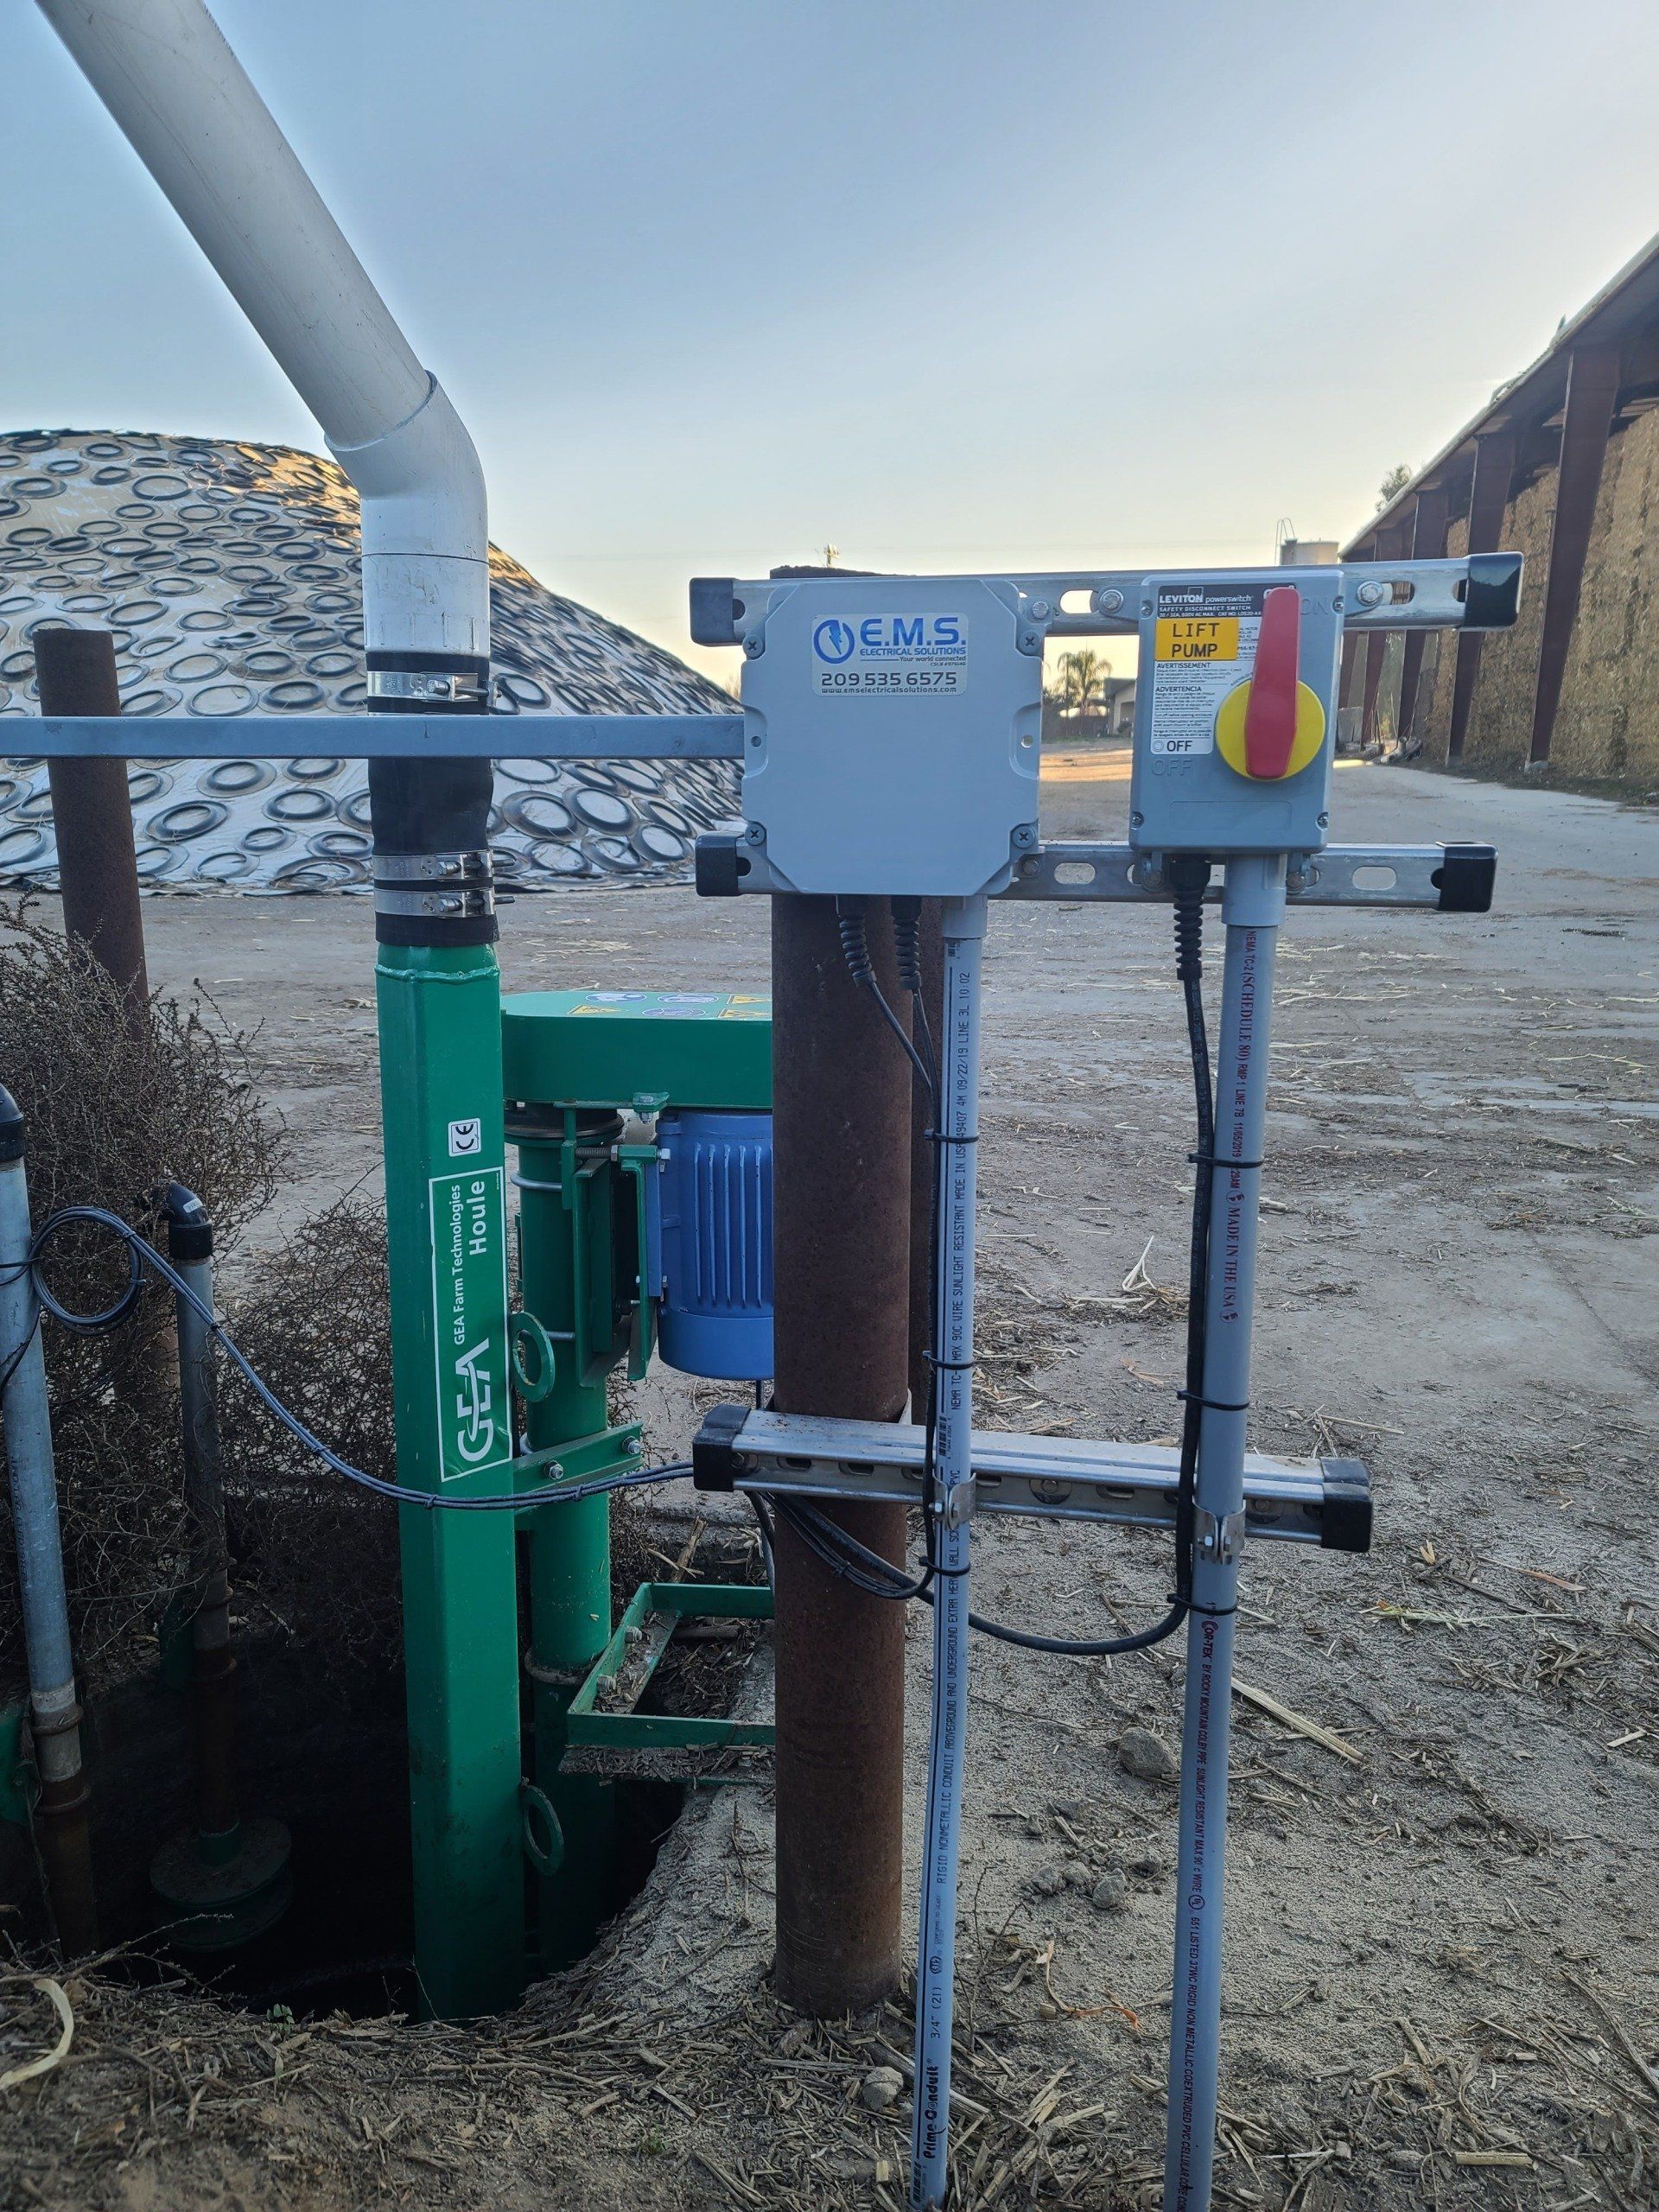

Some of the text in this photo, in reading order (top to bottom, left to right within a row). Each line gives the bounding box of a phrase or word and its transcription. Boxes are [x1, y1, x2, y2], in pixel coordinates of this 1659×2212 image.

[1160, 594, 1203, 604] LEVITON
[860, 617, 966, 646] E.M.S.
[1173, 622, 1220, 638] LIFT
[860, 647, 966, 657] ELECTRICAL SOLUTIONS
[1172, 643, 1217, 658] PUMP
[821, 671, 957, 686] 209 535 6575
[1166, 741, 1192, 752] OFF
[1151, 760, 1192, 776] OFF
[1244, 931, 1256, 952] NEMA
[1243, 955, 1255, 971] TC-2
[959, 972, 969, 999] 10:02
[959, 1005, 969, 1016] 3L
[1239, 972, 1255, 1041] (SCHEDULE
[958, 1021, 969, 1043] LINE
[1235, 1045, 1251, 1061] 80)
[957, 1047, 968, 1090] 09/22/19
[1236, 1064, 1249, 1079] RMP
[957, 1095, 967, 1106] 4M
[1235, 1090, 1246, 1105] LINE
[1232, 1122, 1243, 1158] 11/05/2019
[955, 1163, 965, 1173] IN
[955, 1179, 965, 1199] MADE
[466, 1180, 486, 1255] Houle
[954, 1205, 964, 1250] RESISTANT
[1226, 1207, 1241, 1242] MADE
[1226, 1245, 1239, 1257] IN
[449, 1185, 465, 1345] GEA Farm Technologies
[953, 1256, 963, 1295] SUNLIGHT
[1224, 1260, 1238, 1283] THE
[1223, 1286, 1236, 1307] USA
[952, 1300, 963, 1320] WIRE
[952, 1325, 963, 1340] 90C
[951, 1346, 962, 1360] MAX
[951, 1369, 962, 1384] TC-
[455, 1338, 493, 1462] GEA
[950, 1389, 961, 1409] NEMA
[949, 1546, 959, 1566] WALL
[948, 1599, 958, 1622] EXTRA
[947, 1628, 957, 1678] UNDERGROUND
[1203, 1664, 1213, 1673] BY
[947, 1682, 957, 1696] AND
[1200, 1674, 1213, 1695] ROCKY
[1198, 1696, 1211, 1729] MOUNTAIN
[945, 1700, 956, 1749] ABOVEGROUND
[1196, 1730, 1209, 1751] COLBY
[1196, 1751, 1207, 1764] PIPE
[942, 1754, 954, 1788] CONDUIT
[1195, 1768, 1206, 1799] SUNLIGHT
[938, 1793, 951, 1850] NONMETALLIC
[1194, 1800, 1205, 1839] RESISTANT
[1193, 1840, 1205, 1855] MAX
[936, 1855, 948, 1884] RIGID
[1192, 1873, 1202, 1891] WIRE
[1190, 1917, 1200, 1929] 651
[1189, 1932, 1199, 1959] LISTED
[931, 1986, 942, 2008] (21)
[1187, 1984, 1198, 2006] RIGID
[1185, 2008, 1197, 2025] NON
[1184, 2027, 1197, 2067] METALLIC
[1182, 2069, 1194, 2123] COEXTRUDED
[1181, 2125, 1192, 2140] PVC
[1179, 2141, 1191, 2177] CELLULAR
[1178, 2177, 1190, 2196] CORE
